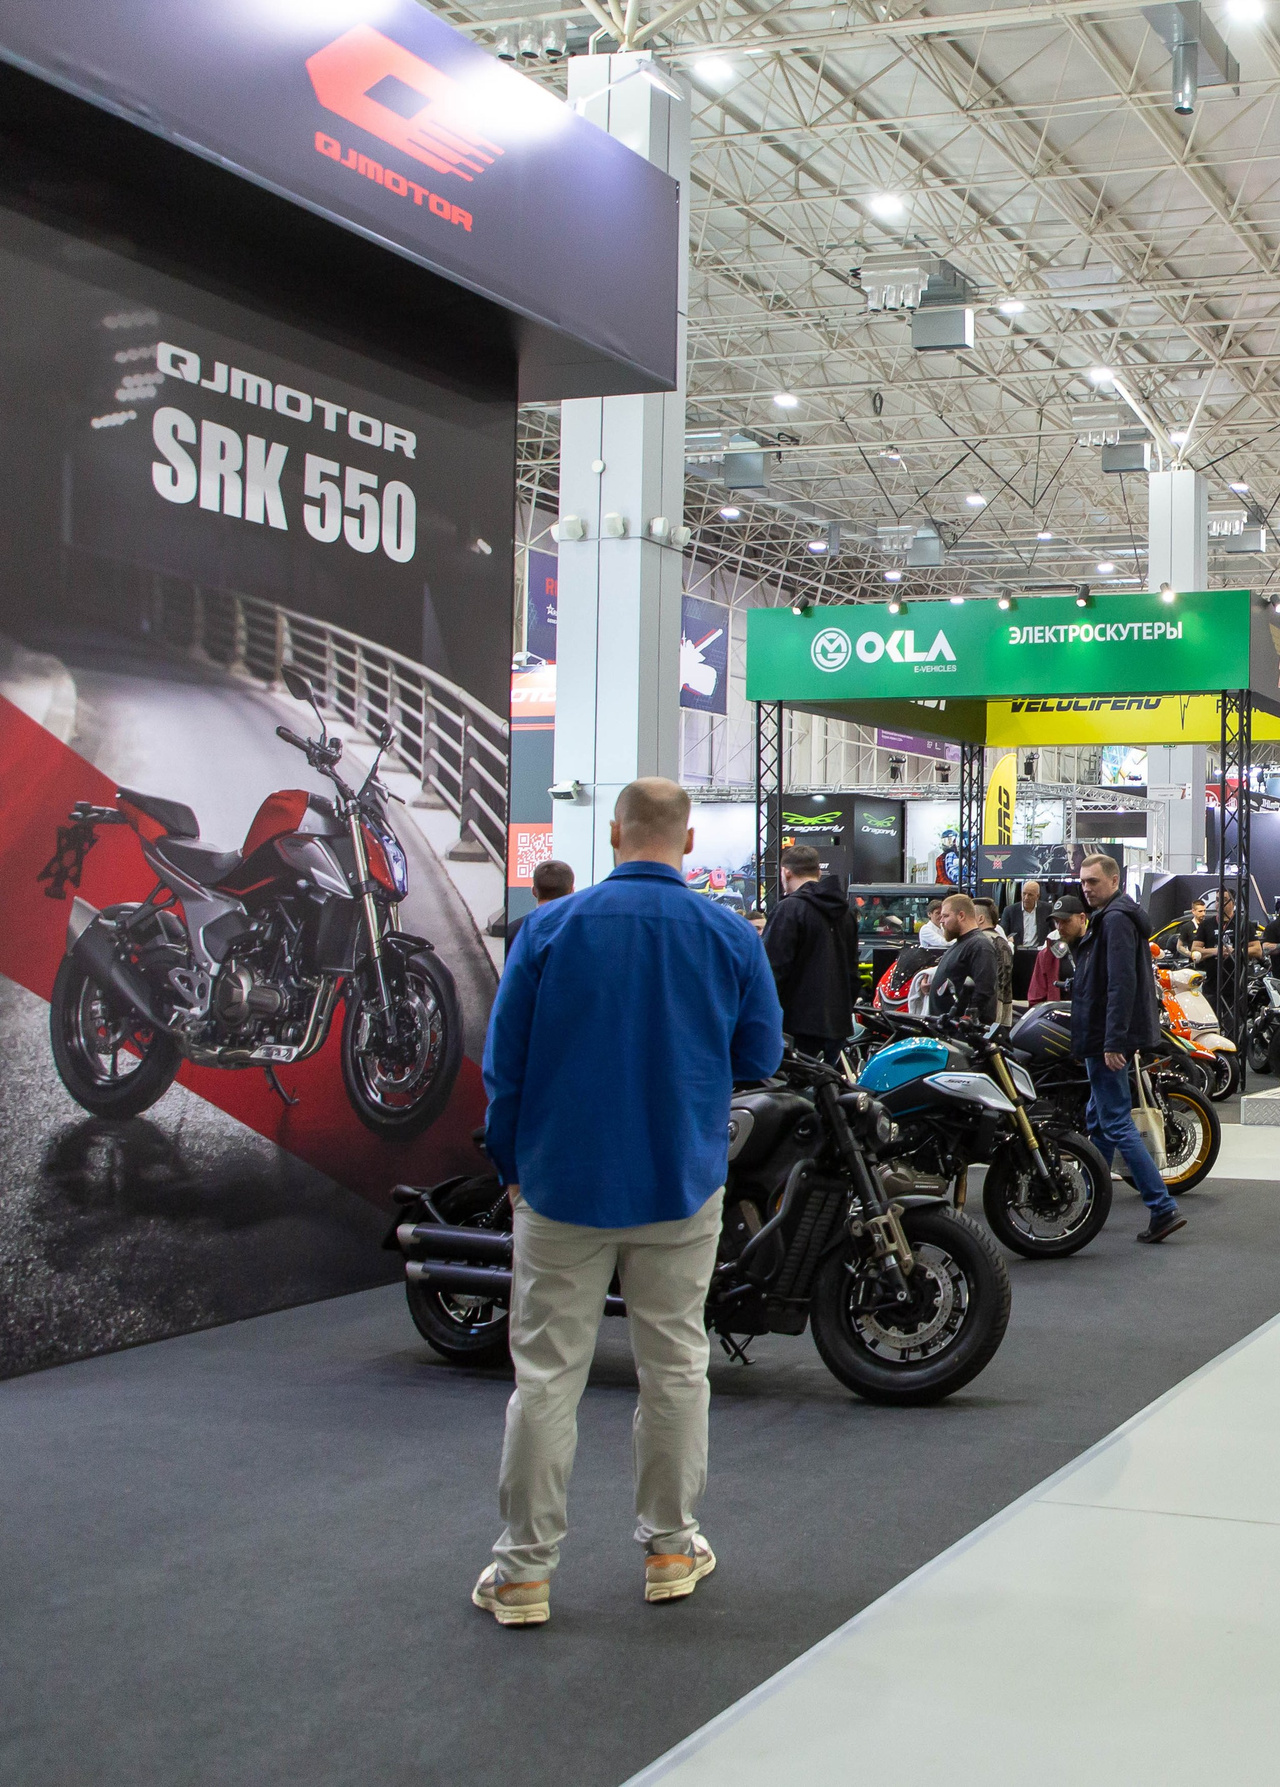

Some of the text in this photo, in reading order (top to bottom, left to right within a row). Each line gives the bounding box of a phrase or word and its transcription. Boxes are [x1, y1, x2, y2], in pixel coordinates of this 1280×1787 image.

[314, 130, 473, 233] QJMOTOR
[156, 341, 417, 459] QJMOTOR
[152, 406, 417, 564] SRK 550
[913, 664, 957, 673] E-VEHICLES
[1008, 621, 1184, 645] ЭЛЕКТРОСКУТЕРЫ
